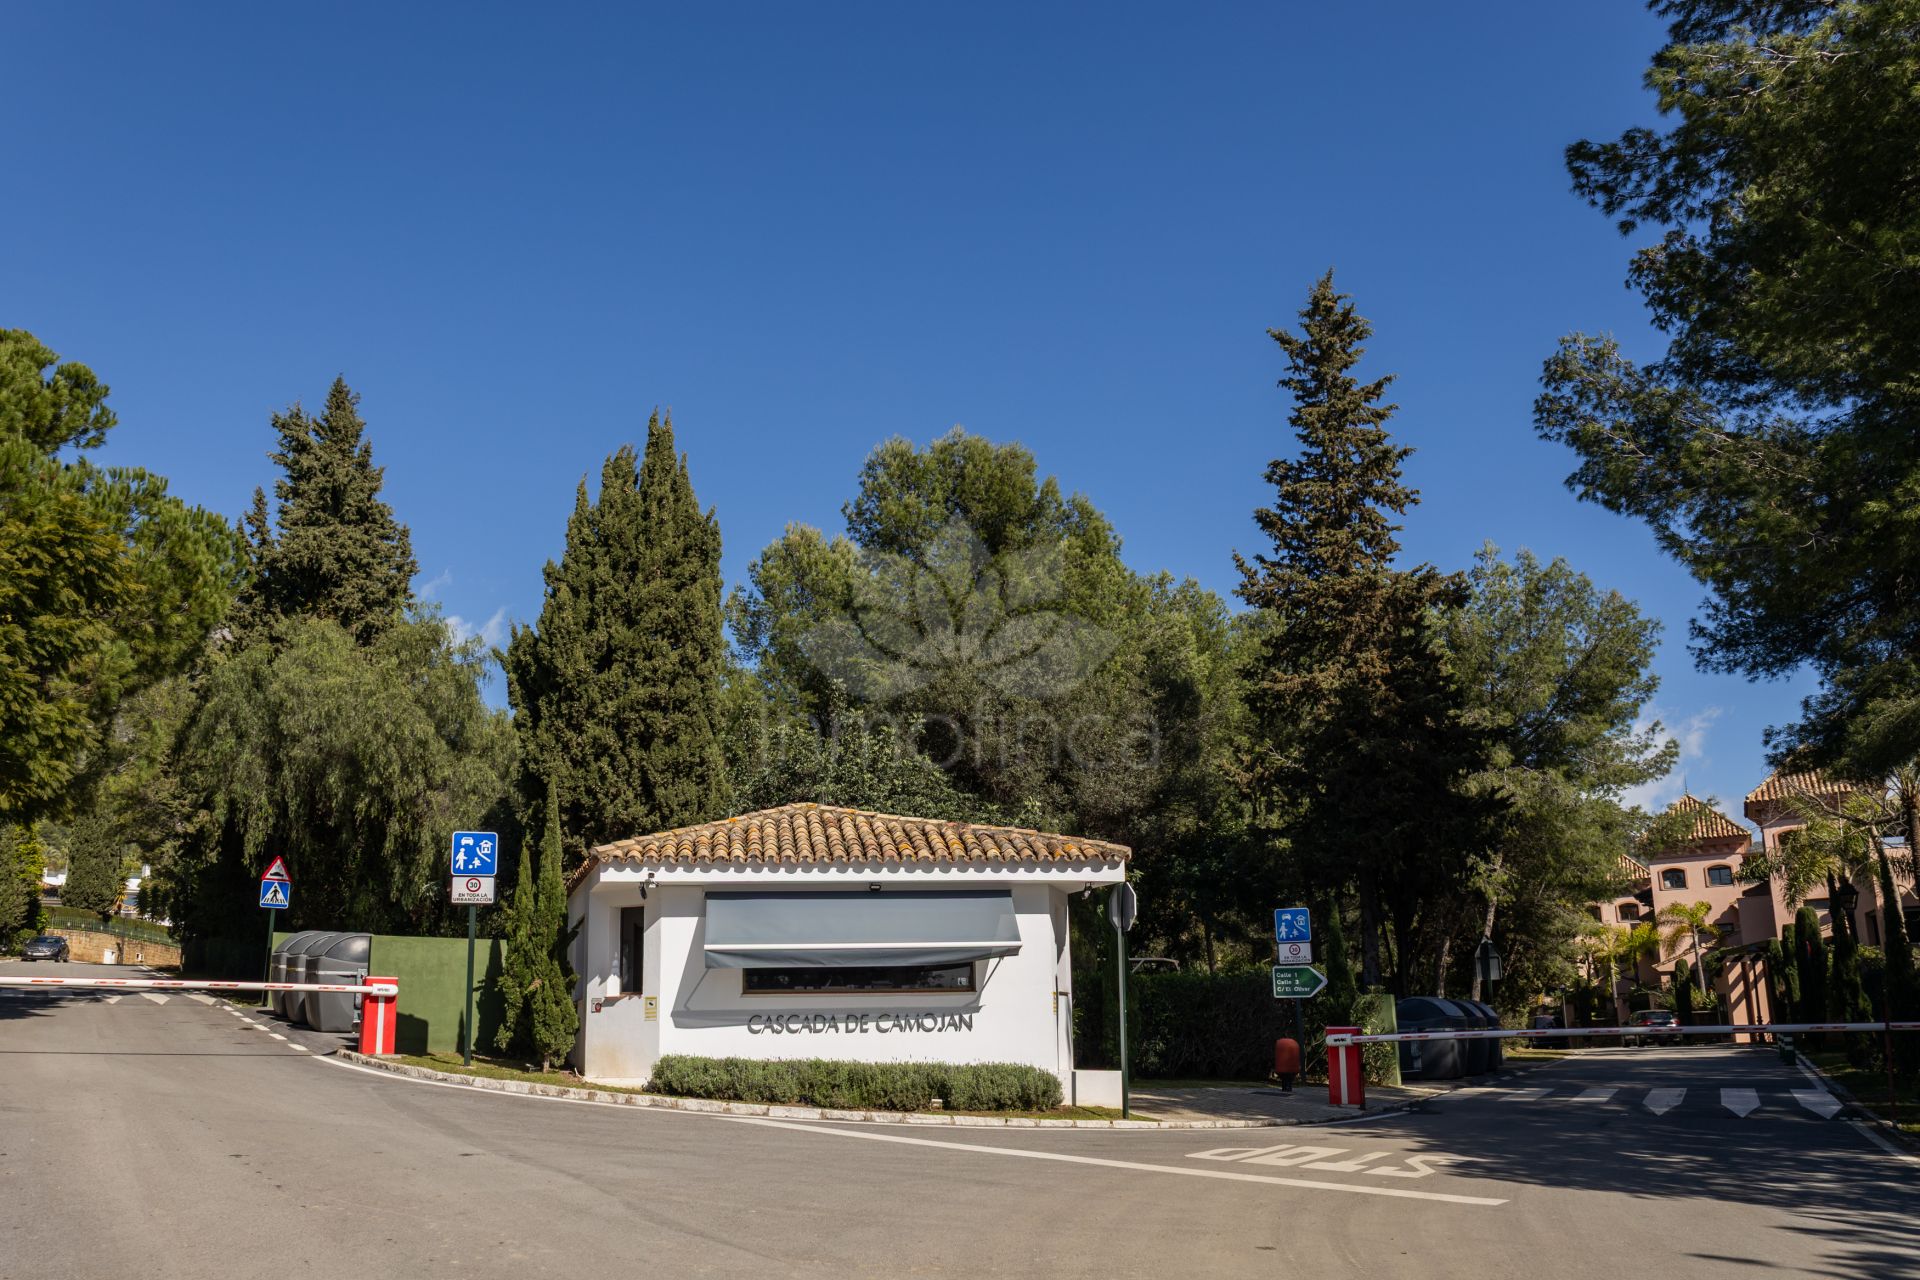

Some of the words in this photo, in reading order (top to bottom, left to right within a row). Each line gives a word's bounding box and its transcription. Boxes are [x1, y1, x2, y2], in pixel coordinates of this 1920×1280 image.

[469, 881, 478, 889] 30
[746, 1013, 840, 1034] CASCADA
[844, 1013, 869, 1034] DE
[875, 1012, 974, 1033] CAMOJAN
[1184, 1144, 1463, 1178] STOP
